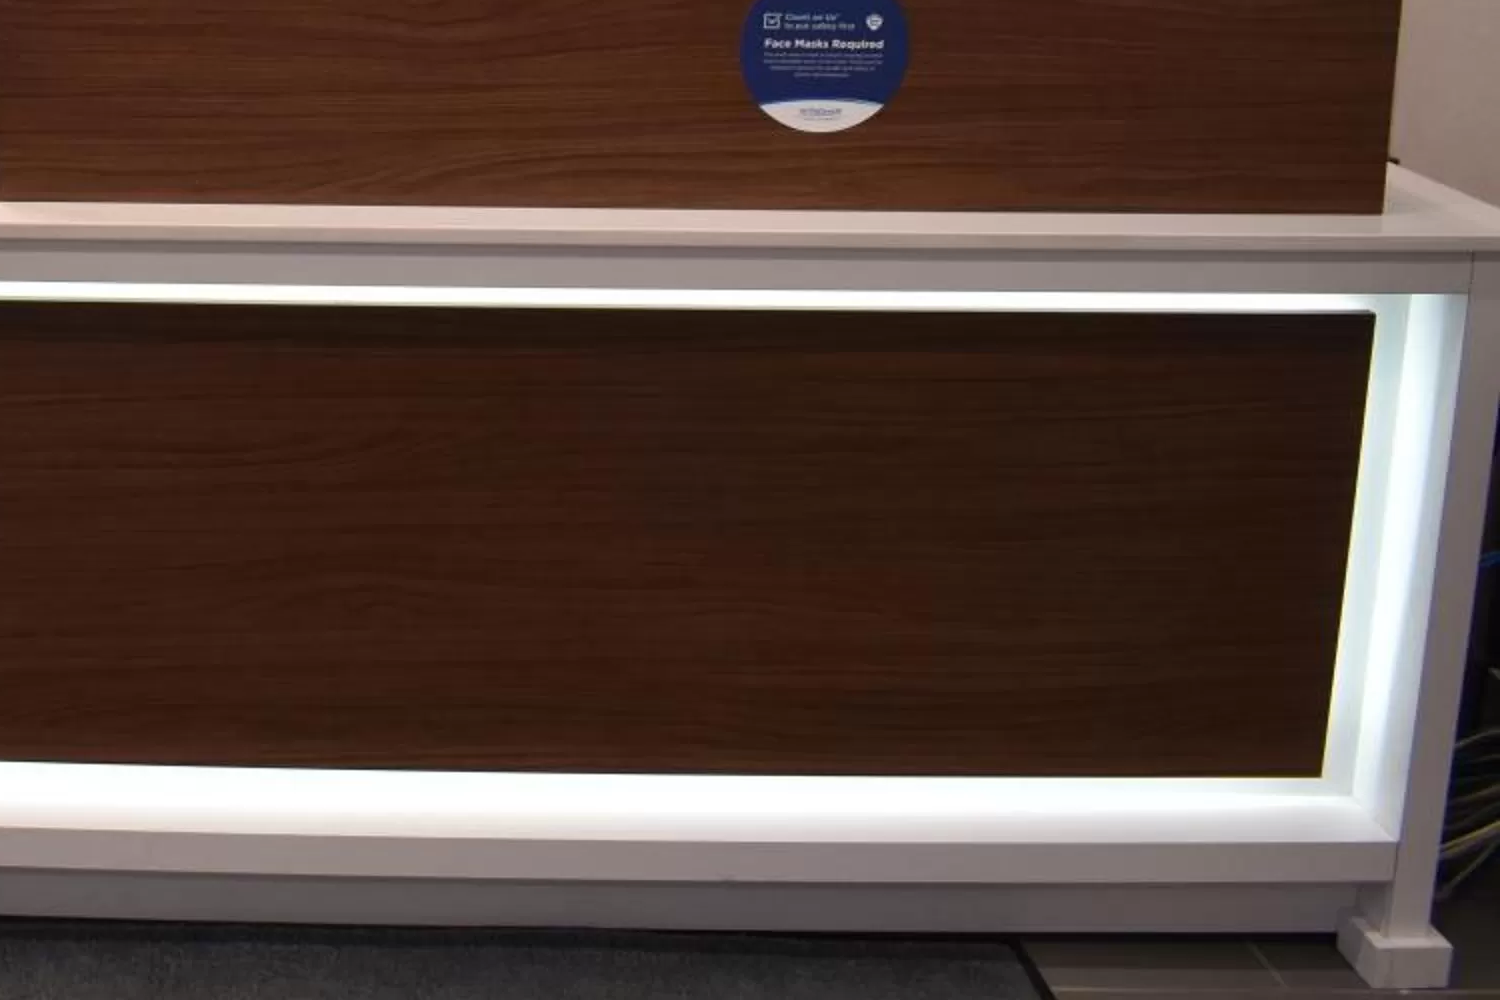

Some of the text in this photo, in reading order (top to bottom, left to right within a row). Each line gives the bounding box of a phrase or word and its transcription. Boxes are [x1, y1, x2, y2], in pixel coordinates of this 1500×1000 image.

[764, 38, 884, 51] Face Masks Required
